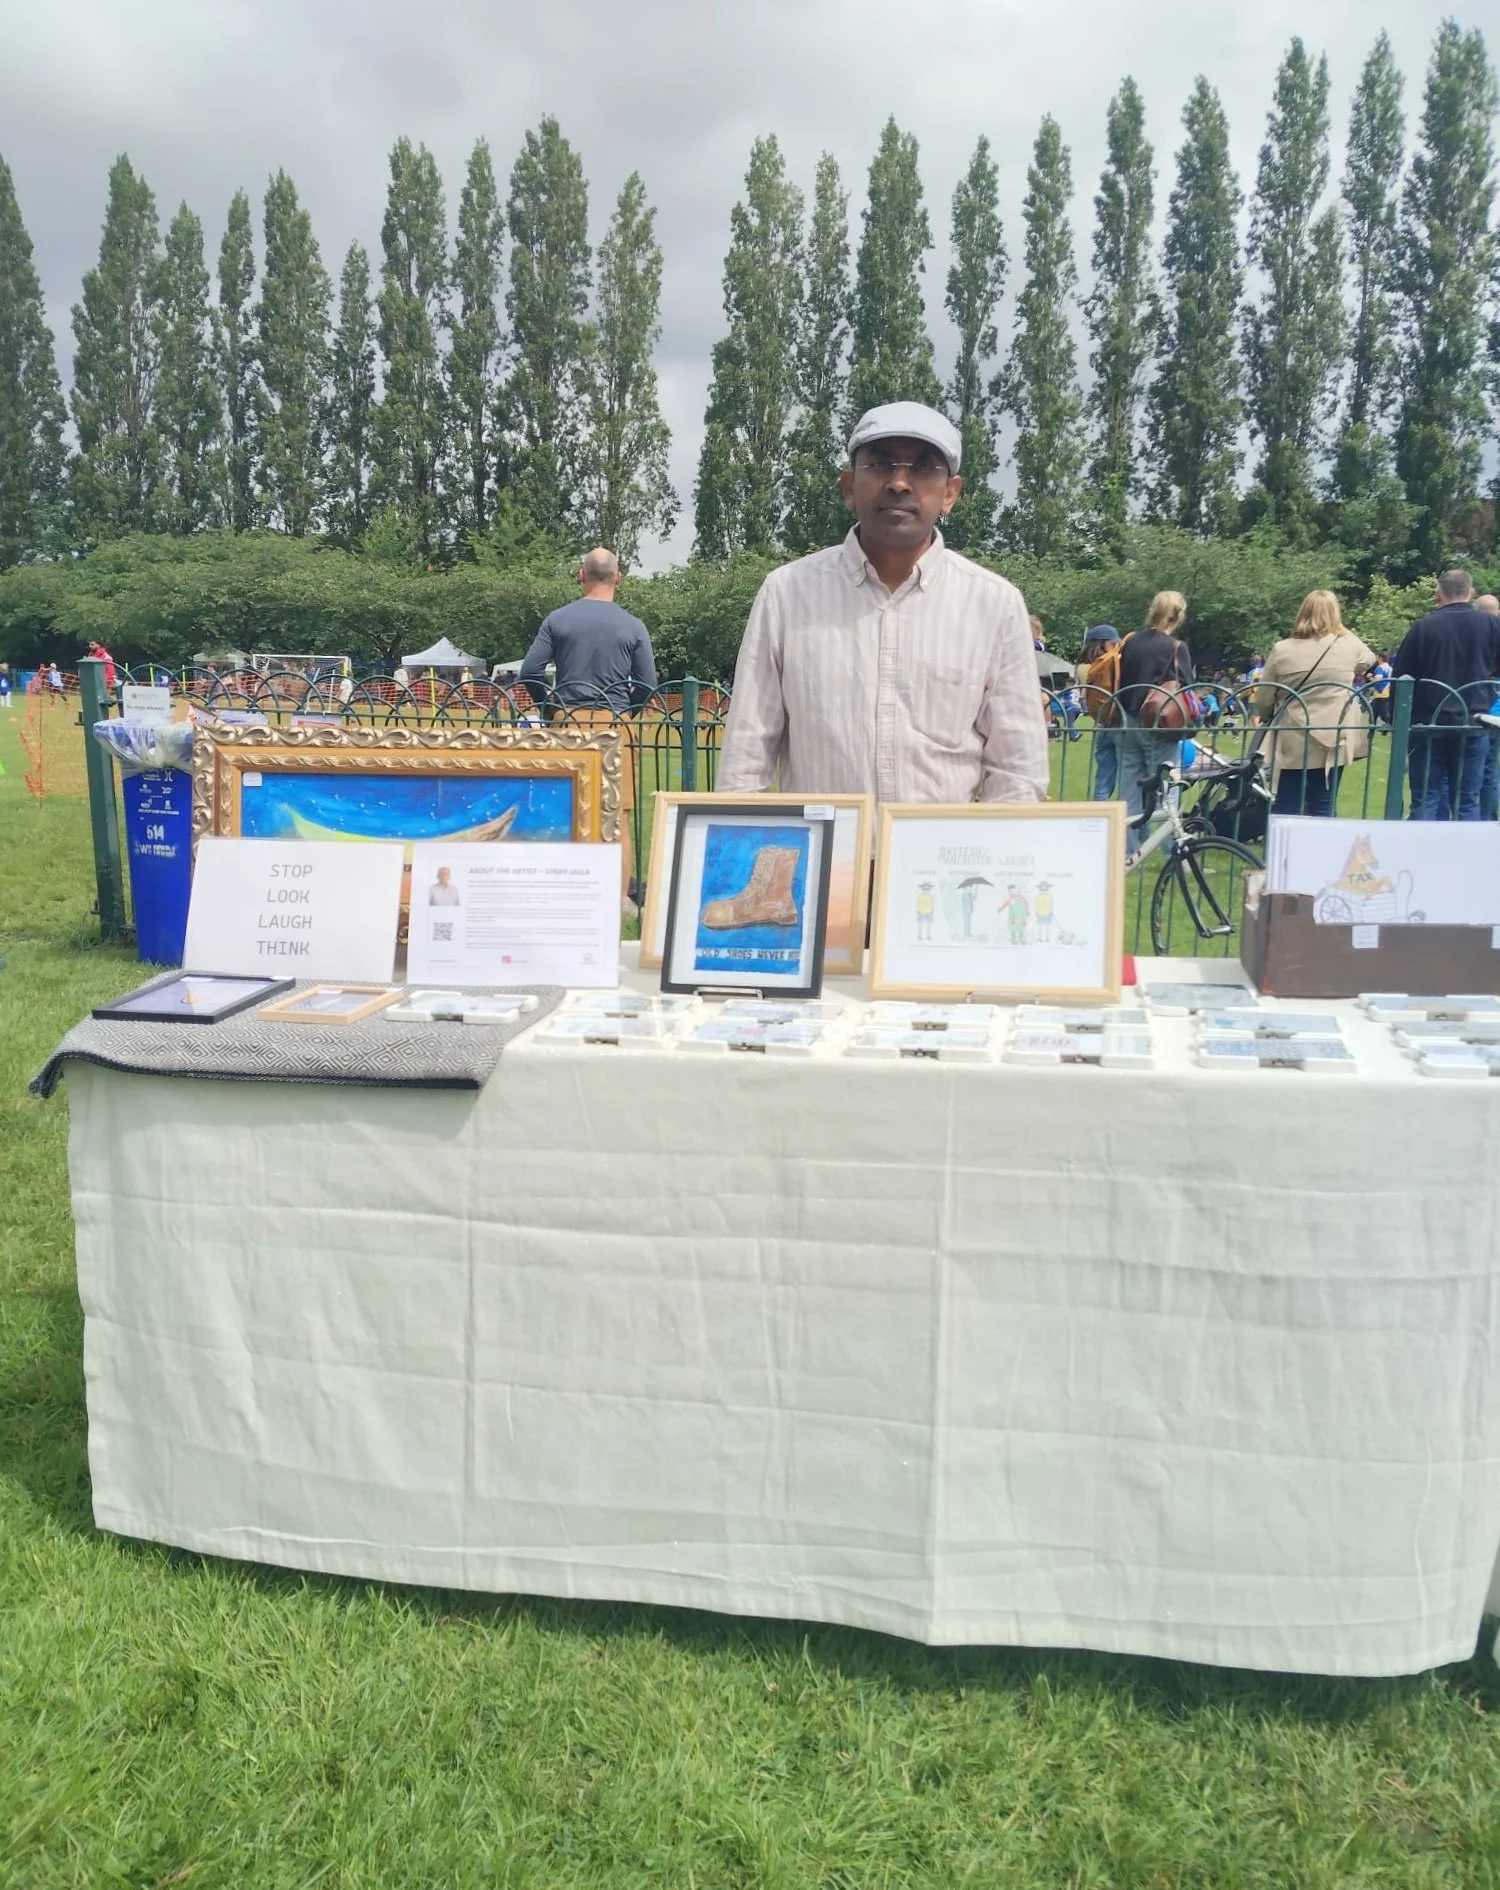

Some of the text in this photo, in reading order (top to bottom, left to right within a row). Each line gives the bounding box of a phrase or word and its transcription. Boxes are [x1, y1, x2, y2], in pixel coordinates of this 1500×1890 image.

[270, 864, 313, 878] STOP
[468, 867, 494, 875] ABOUT
[496, 867, 510, 875] THE
[511, 867, 537, 875] ARTIST
[1347, 871, 1375, 885] TAX
[266, 889, 311, 904] LOOK
[258, 915, 313, 929] LAUGH
[256, 940, 310, 956] THINK
[701, 948, 719, 958] OLD
[727, 949, 752, 960] SHOES
[757, 950, 784, 960] NEVER
